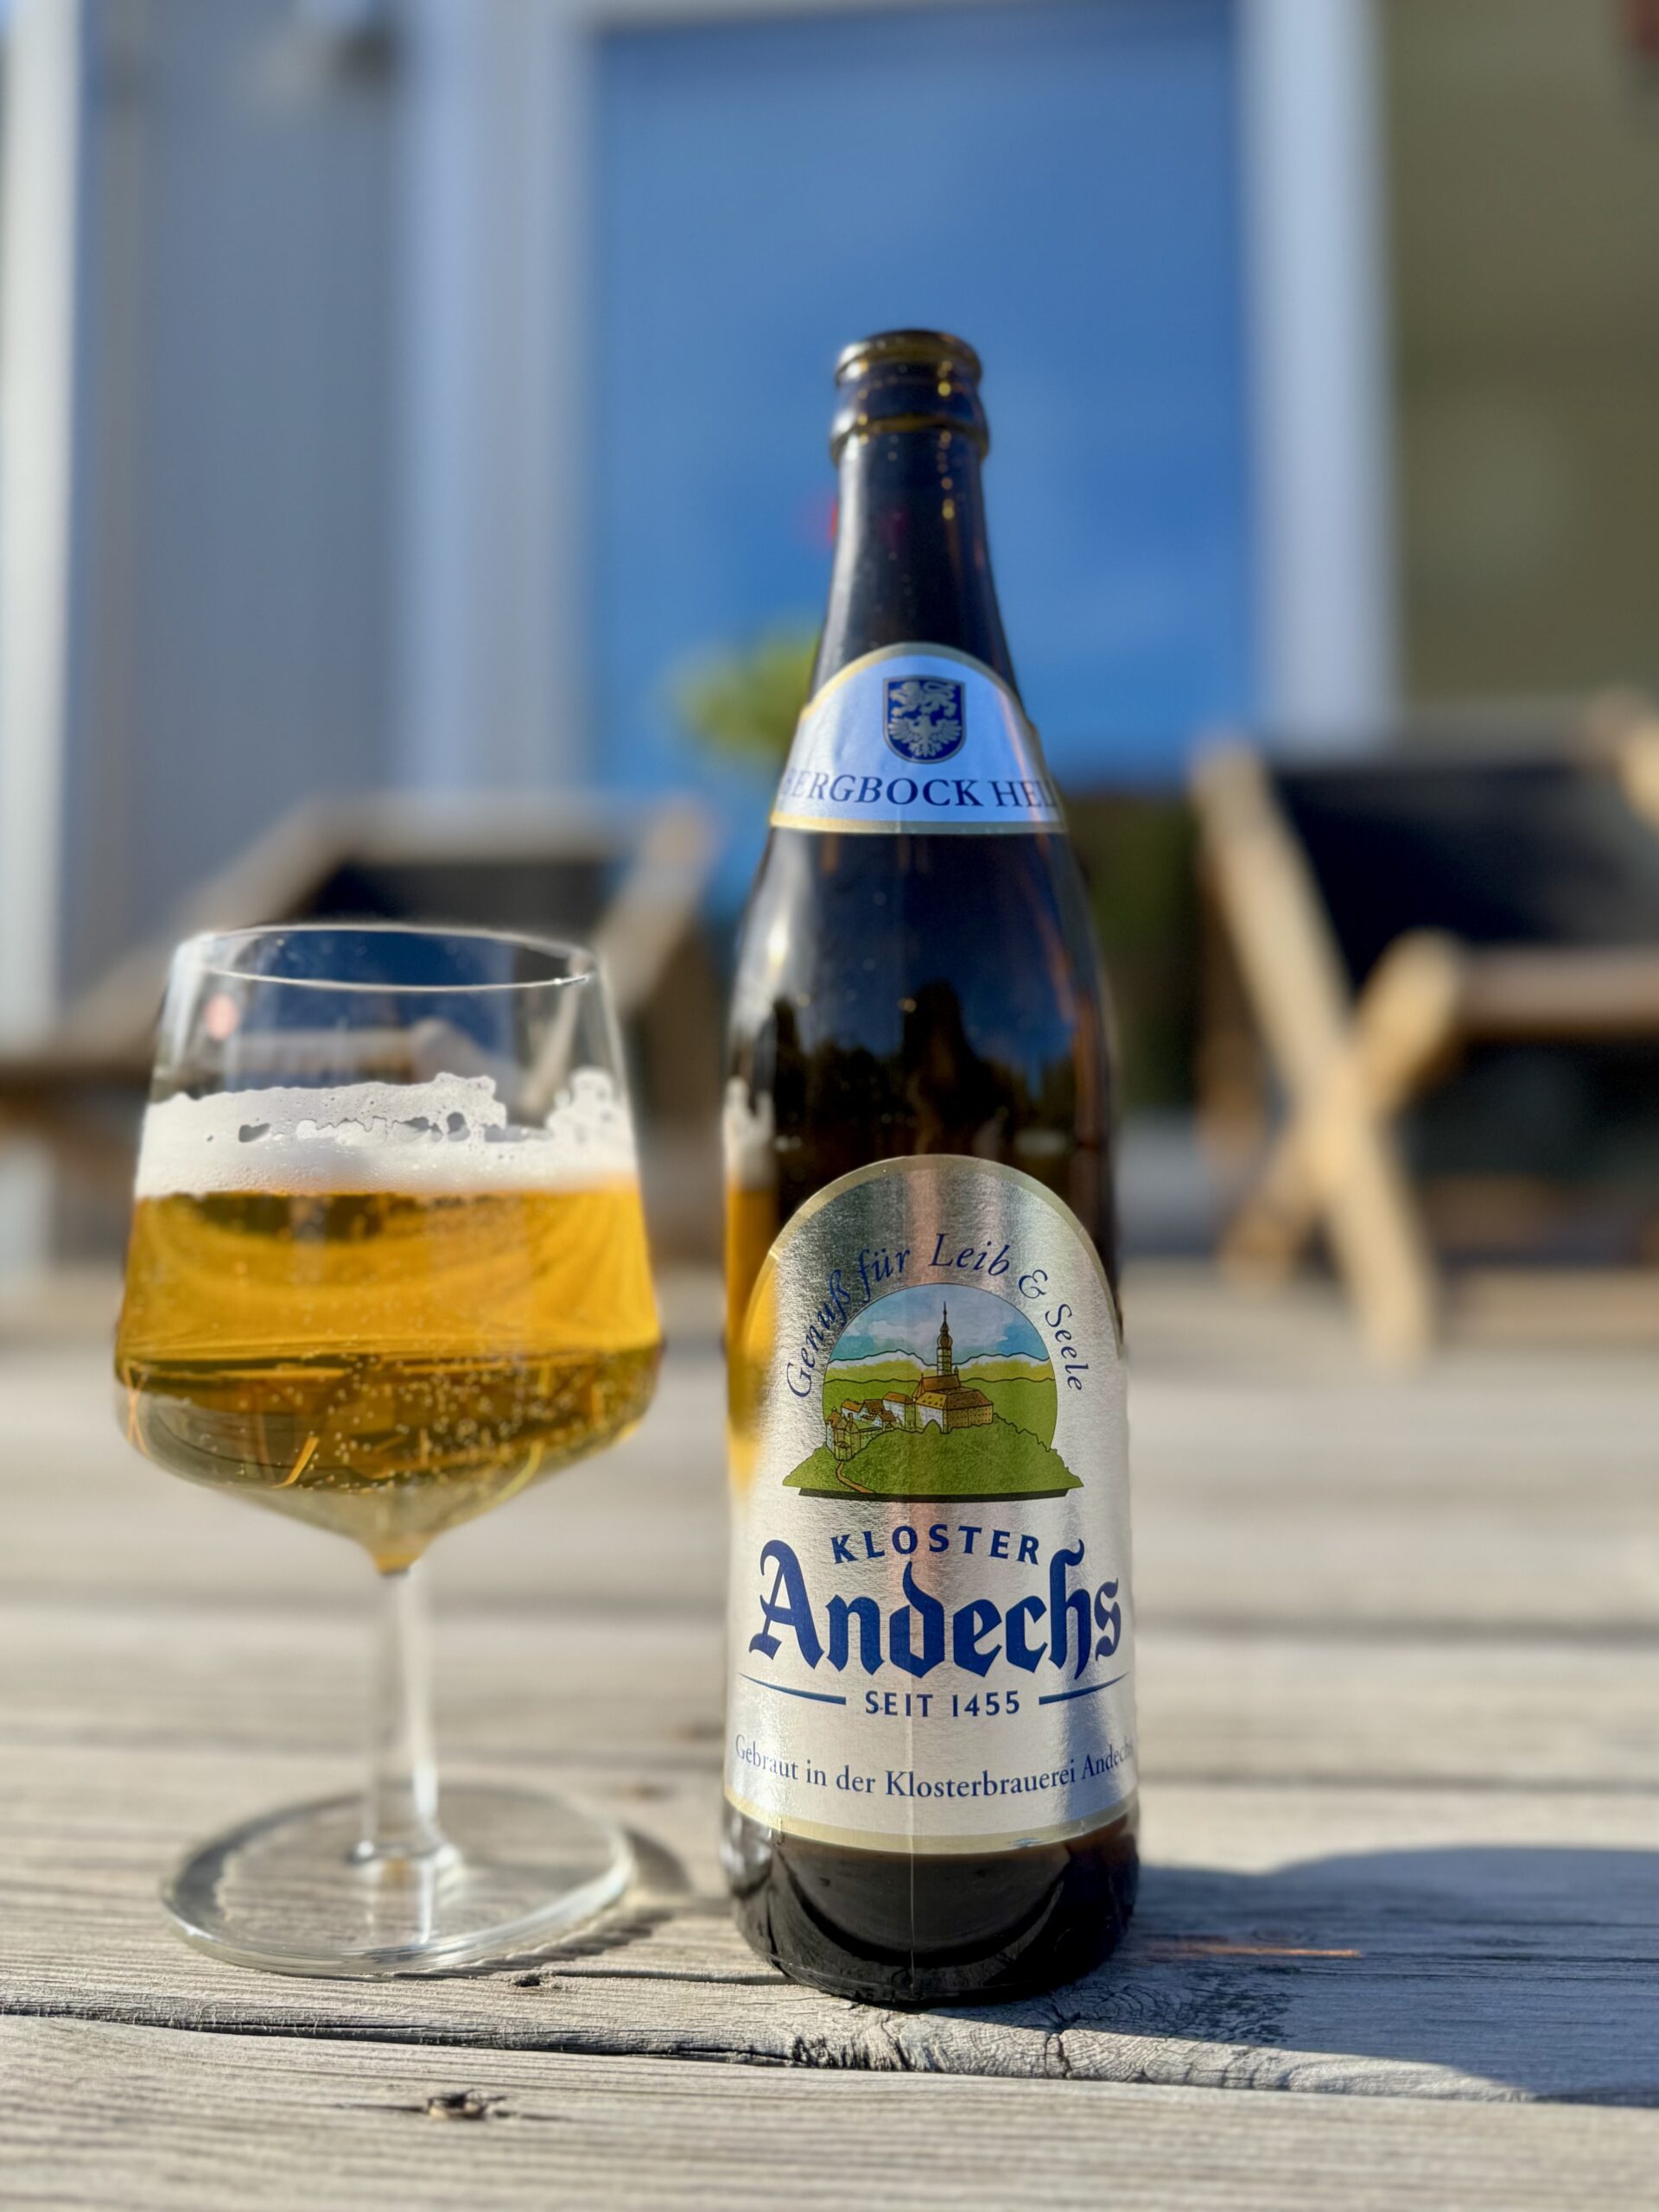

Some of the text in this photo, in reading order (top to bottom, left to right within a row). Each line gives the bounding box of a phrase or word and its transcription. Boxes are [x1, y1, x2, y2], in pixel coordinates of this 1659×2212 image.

[786, 1233, 1089, 1398] Genuß für Leib & Seele
[831, 1523, 1039, 1565] KLOSTER
[748, 1539, 1122, 1680] Andechs
[865, 1689, 1020, 1718] SEIT 1455
[735, 1733, 798, 1780] Gebraut
[806, 1758, 827, 1787] in
[836, 1764, 875, 1794] der
[885, 1758, 1076, 1797] Klosterbrauerei
